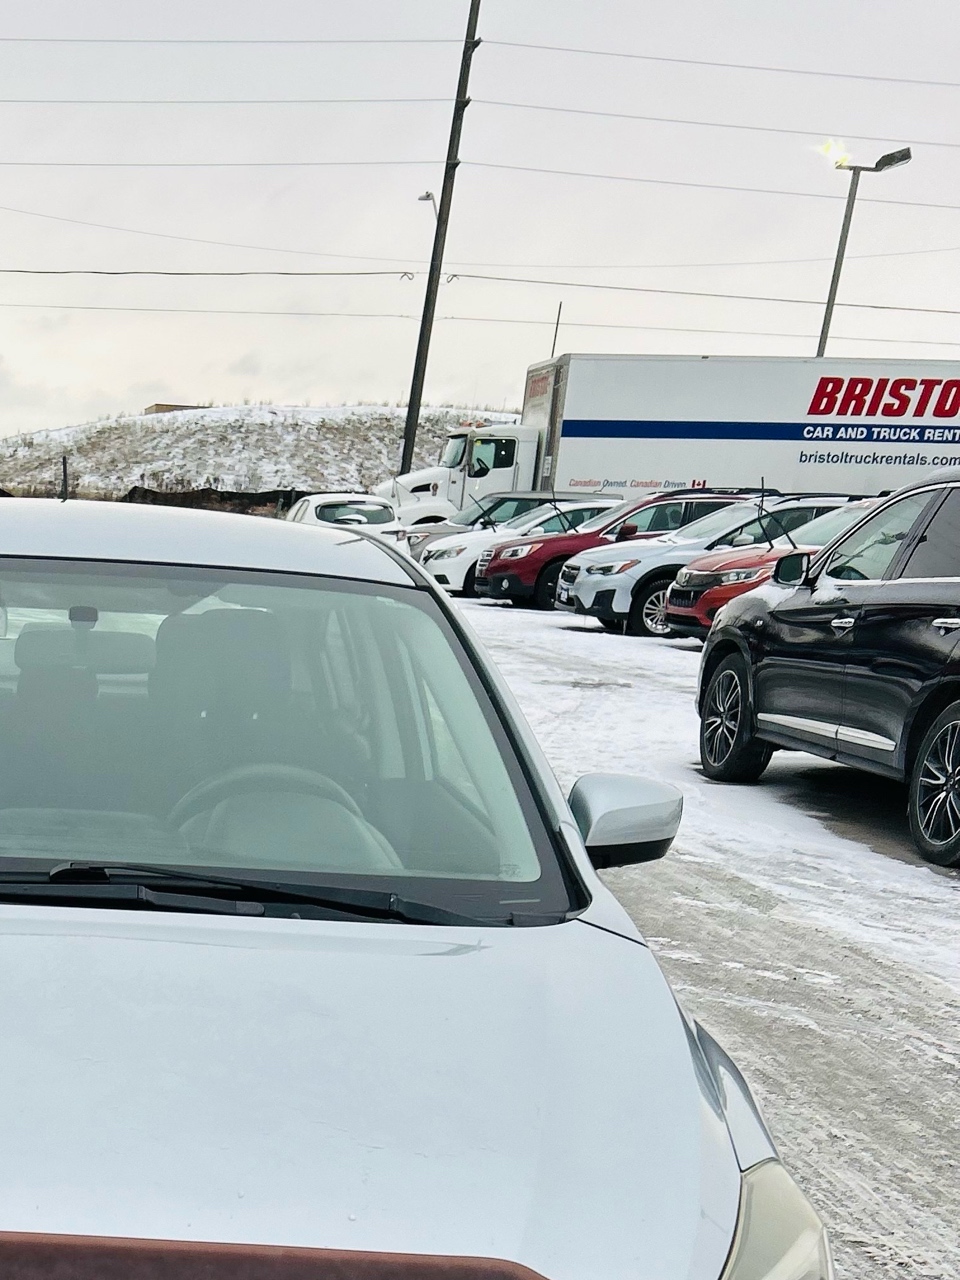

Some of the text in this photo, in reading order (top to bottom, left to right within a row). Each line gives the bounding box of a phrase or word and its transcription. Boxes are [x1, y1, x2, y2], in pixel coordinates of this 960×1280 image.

[803, 426, 834, 439] CAR
[836, 427, 867, 439] AND
[871, 428, 921, 440] TRUCK
[799, 450, 960, 466] bristoltruckrentals.com
[569, 478, 601, 487] Canadian
[630, 480, 661, 488] Canadian
